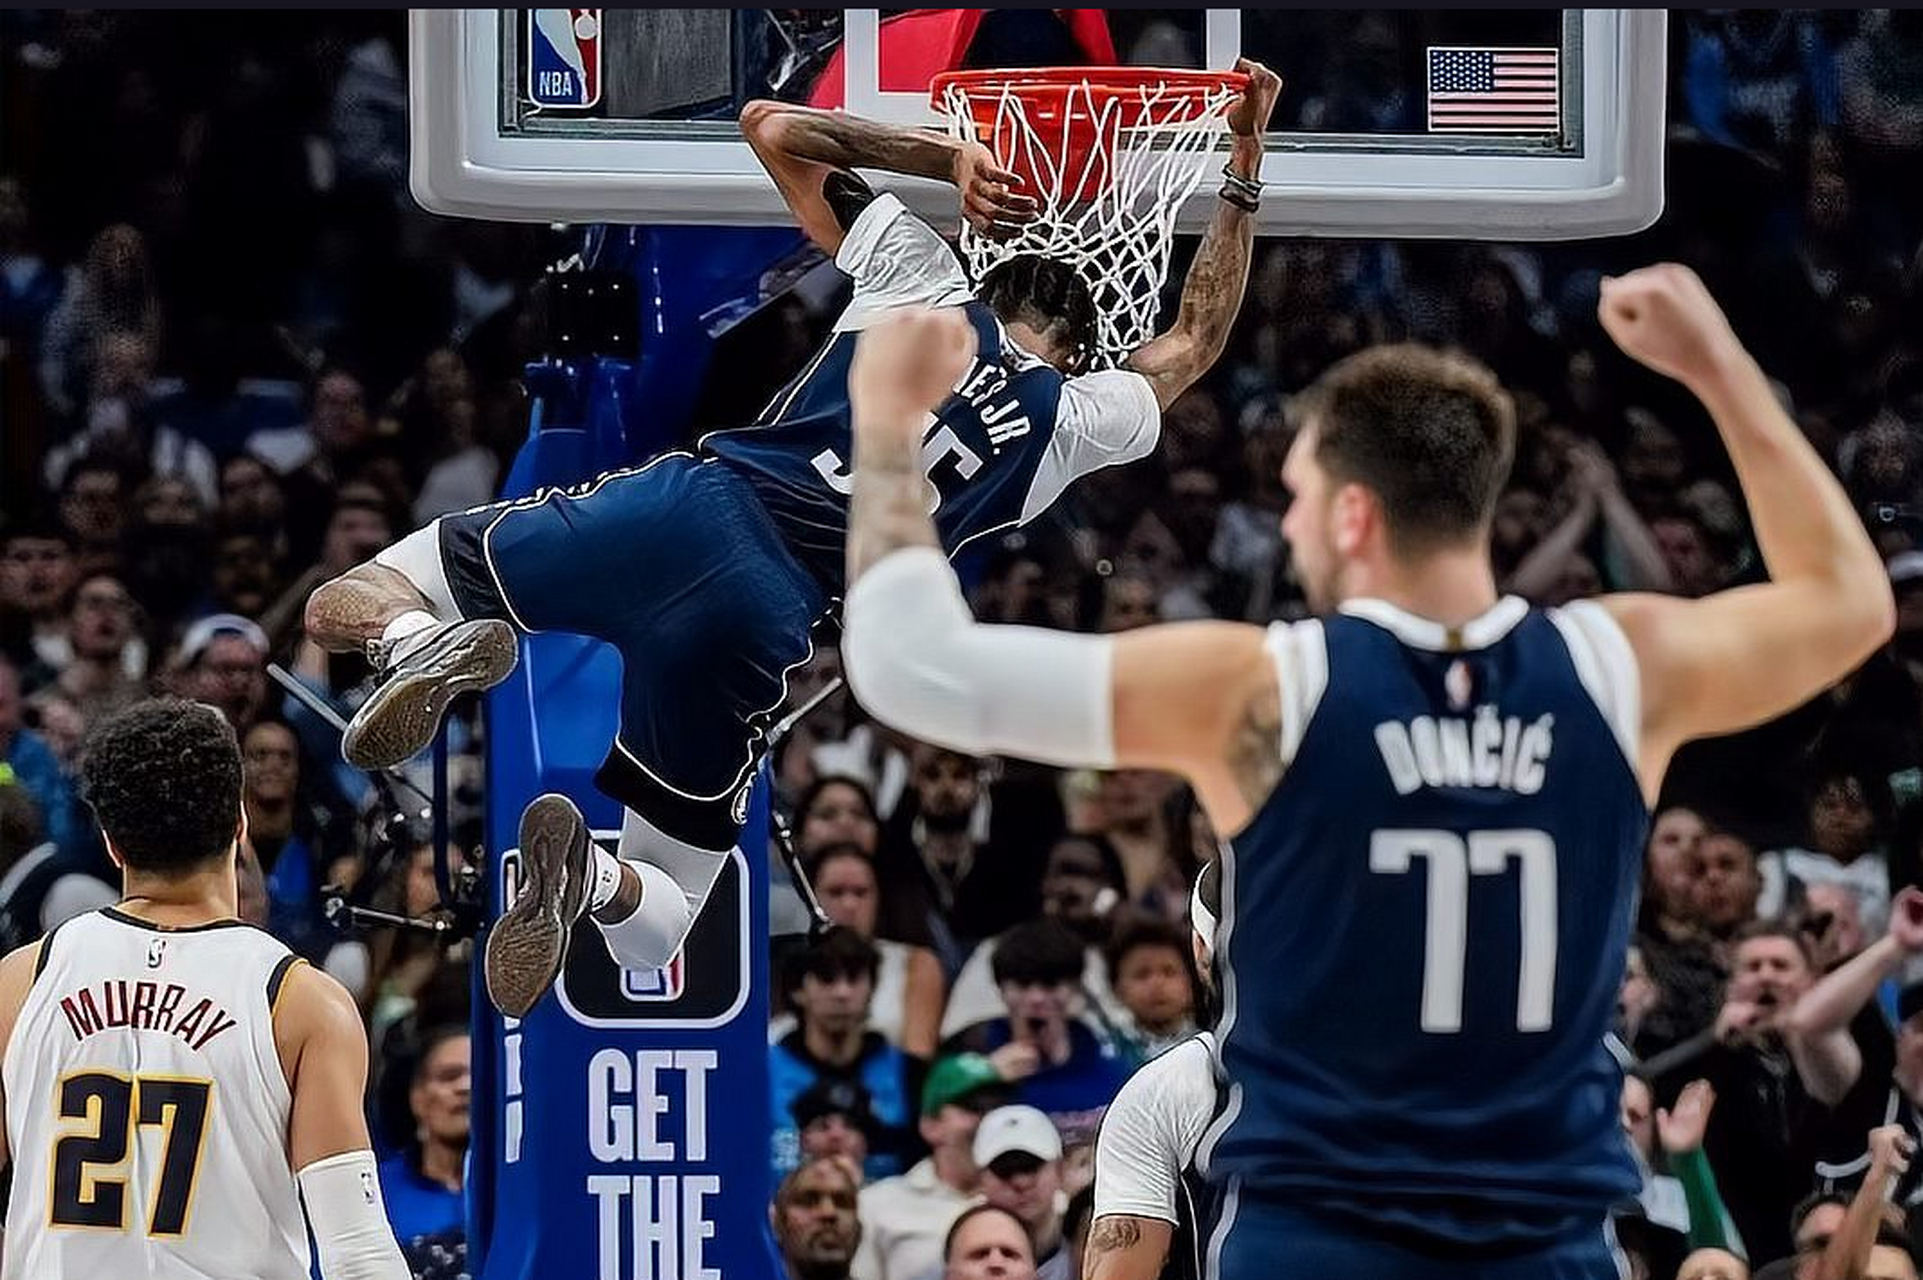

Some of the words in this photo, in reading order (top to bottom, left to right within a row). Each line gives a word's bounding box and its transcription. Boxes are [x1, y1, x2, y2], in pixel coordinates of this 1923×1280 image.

[539, 71, 573, 97] NBA
[1374, 703, 1556, 795] DONČIĆ
[1369, 828, 1558, 1034] 77
[61, 980, 236, 1052] MURRAY
[50, 1072, 214, 1239] 27
[588, 1047, 718, 1163] GET
[587, 1175, 722, 1280] THE
